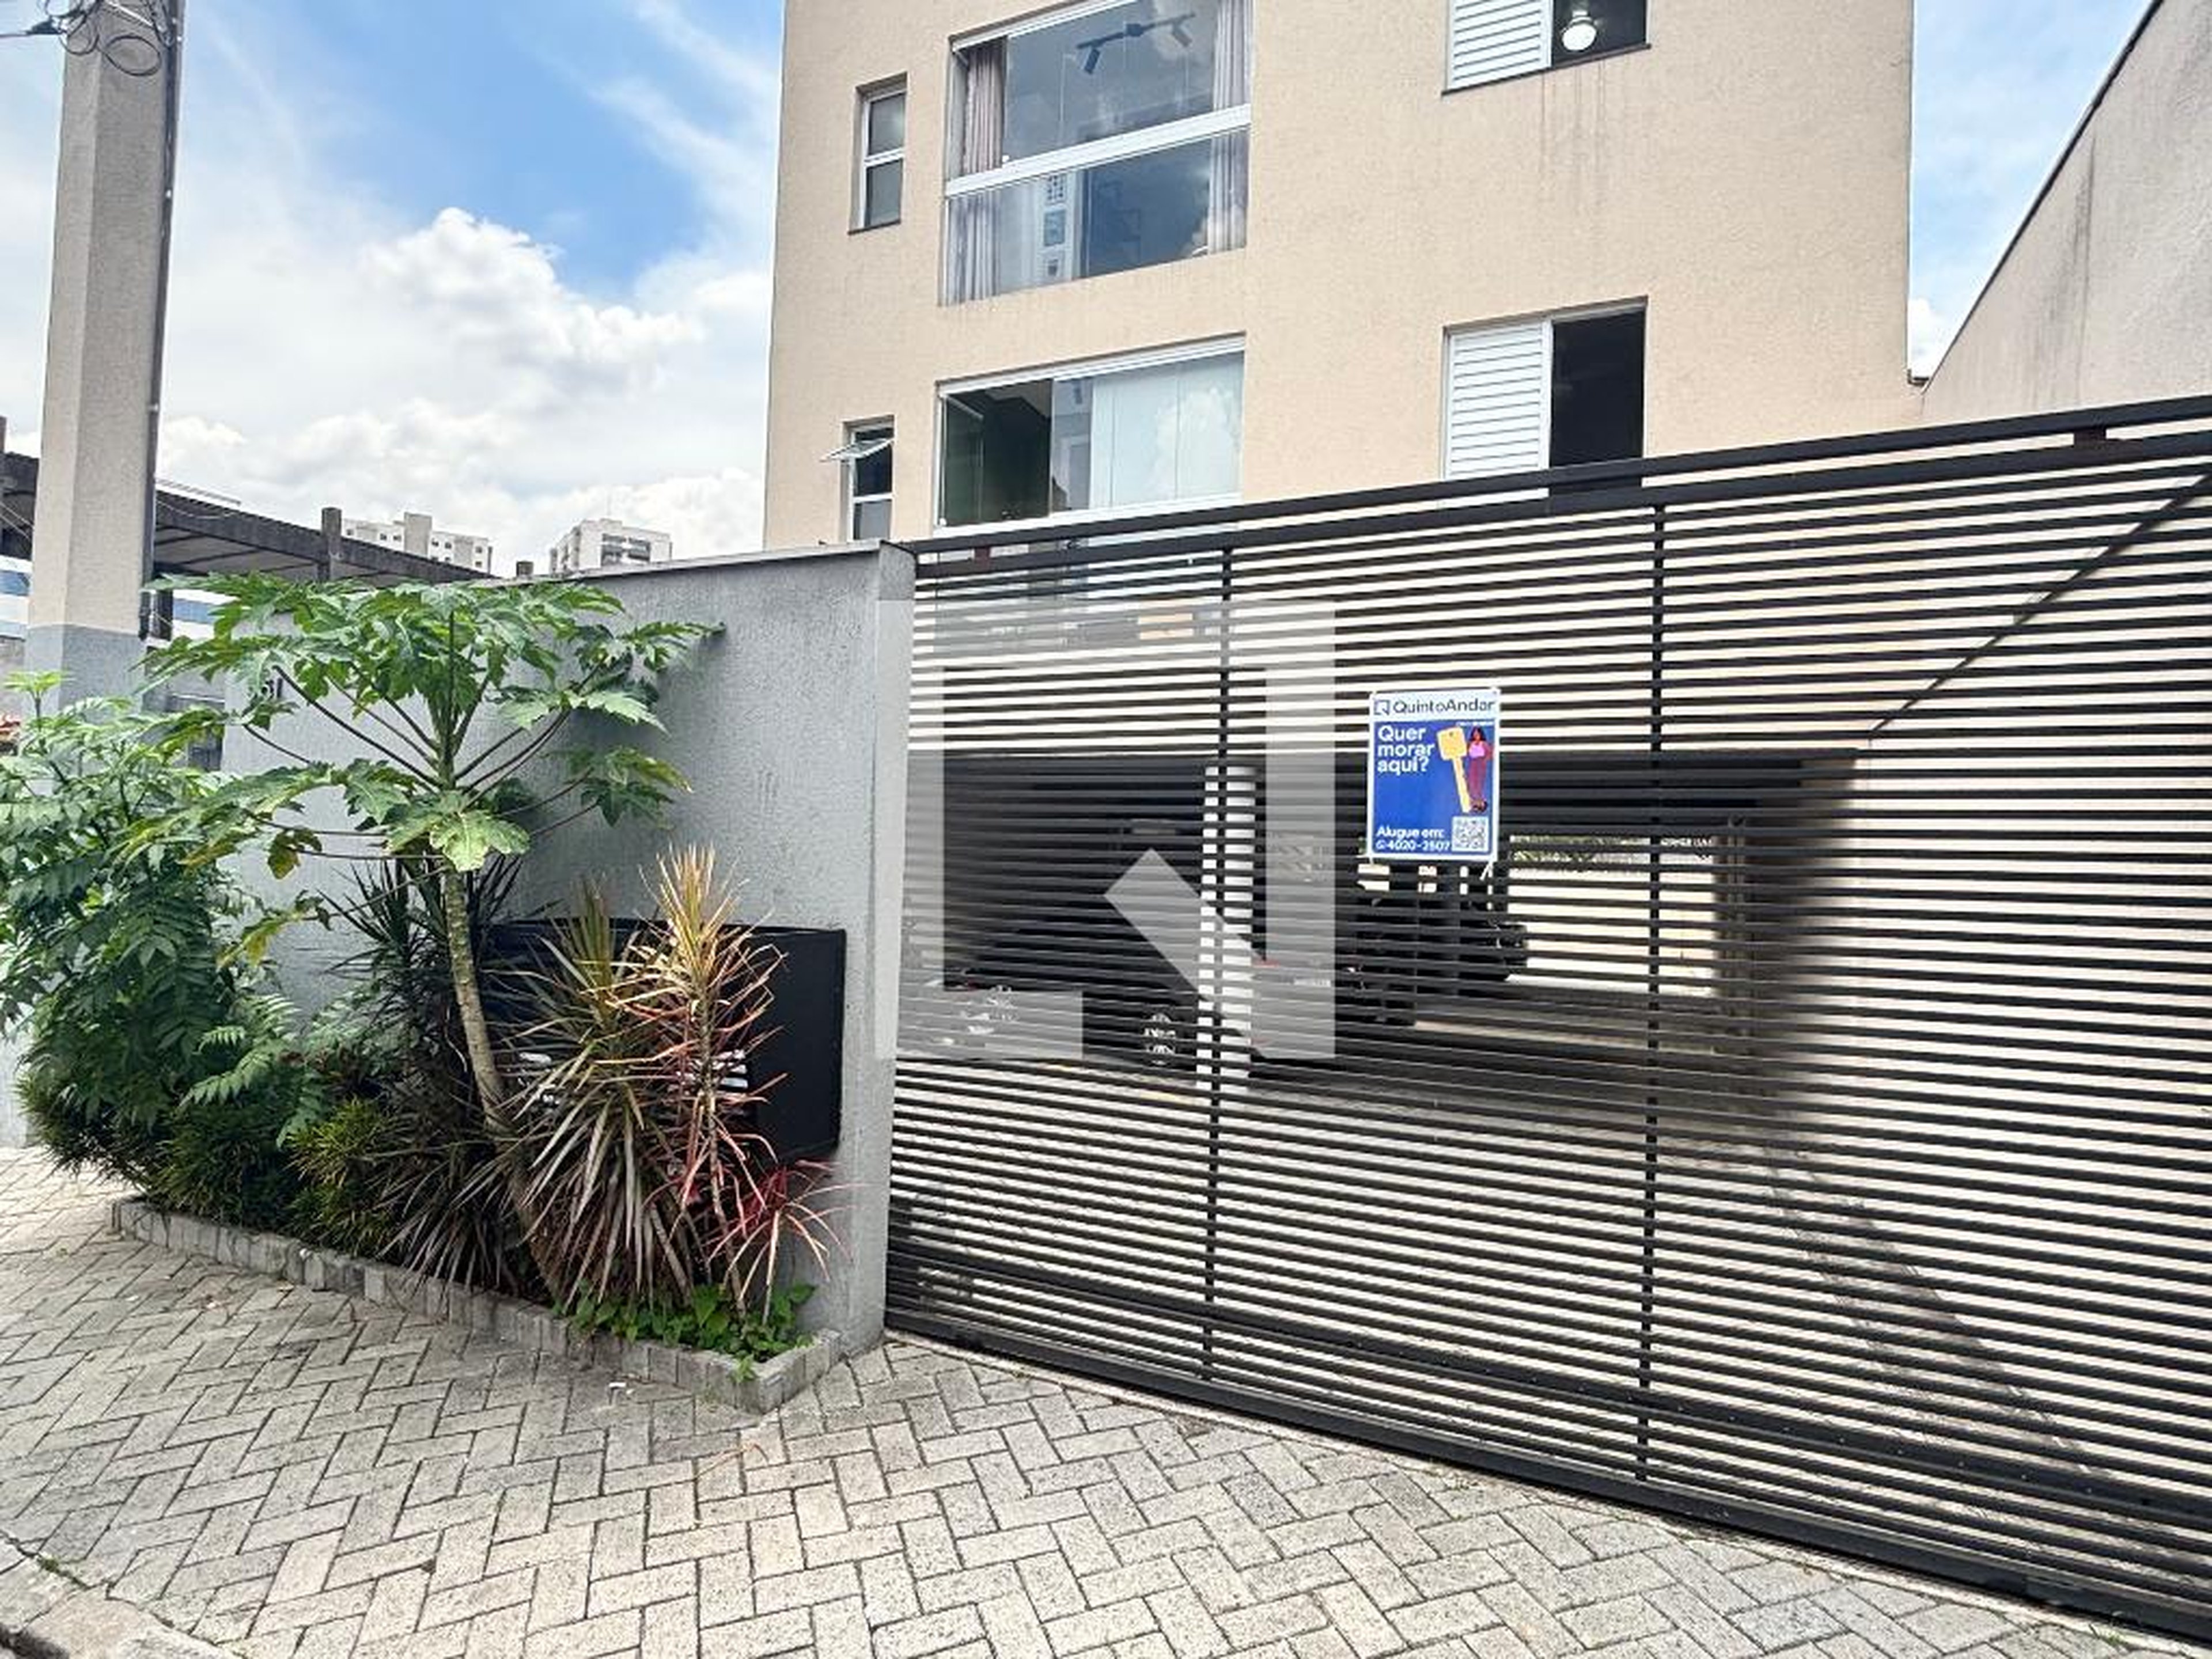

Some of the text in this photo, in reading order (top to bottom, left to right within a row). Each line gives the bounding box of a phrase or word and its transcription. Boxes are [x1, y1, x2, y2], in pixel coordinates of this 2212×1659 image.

[1393, 699, 1495, 714] QuintoAndar
[1377, 725, 1426, 742] Quer
[1377, 743, 1435, 756] morar
[1377, 756, 1429, 776] aqui?
[1376, 825, 1419, 839] Alugue
